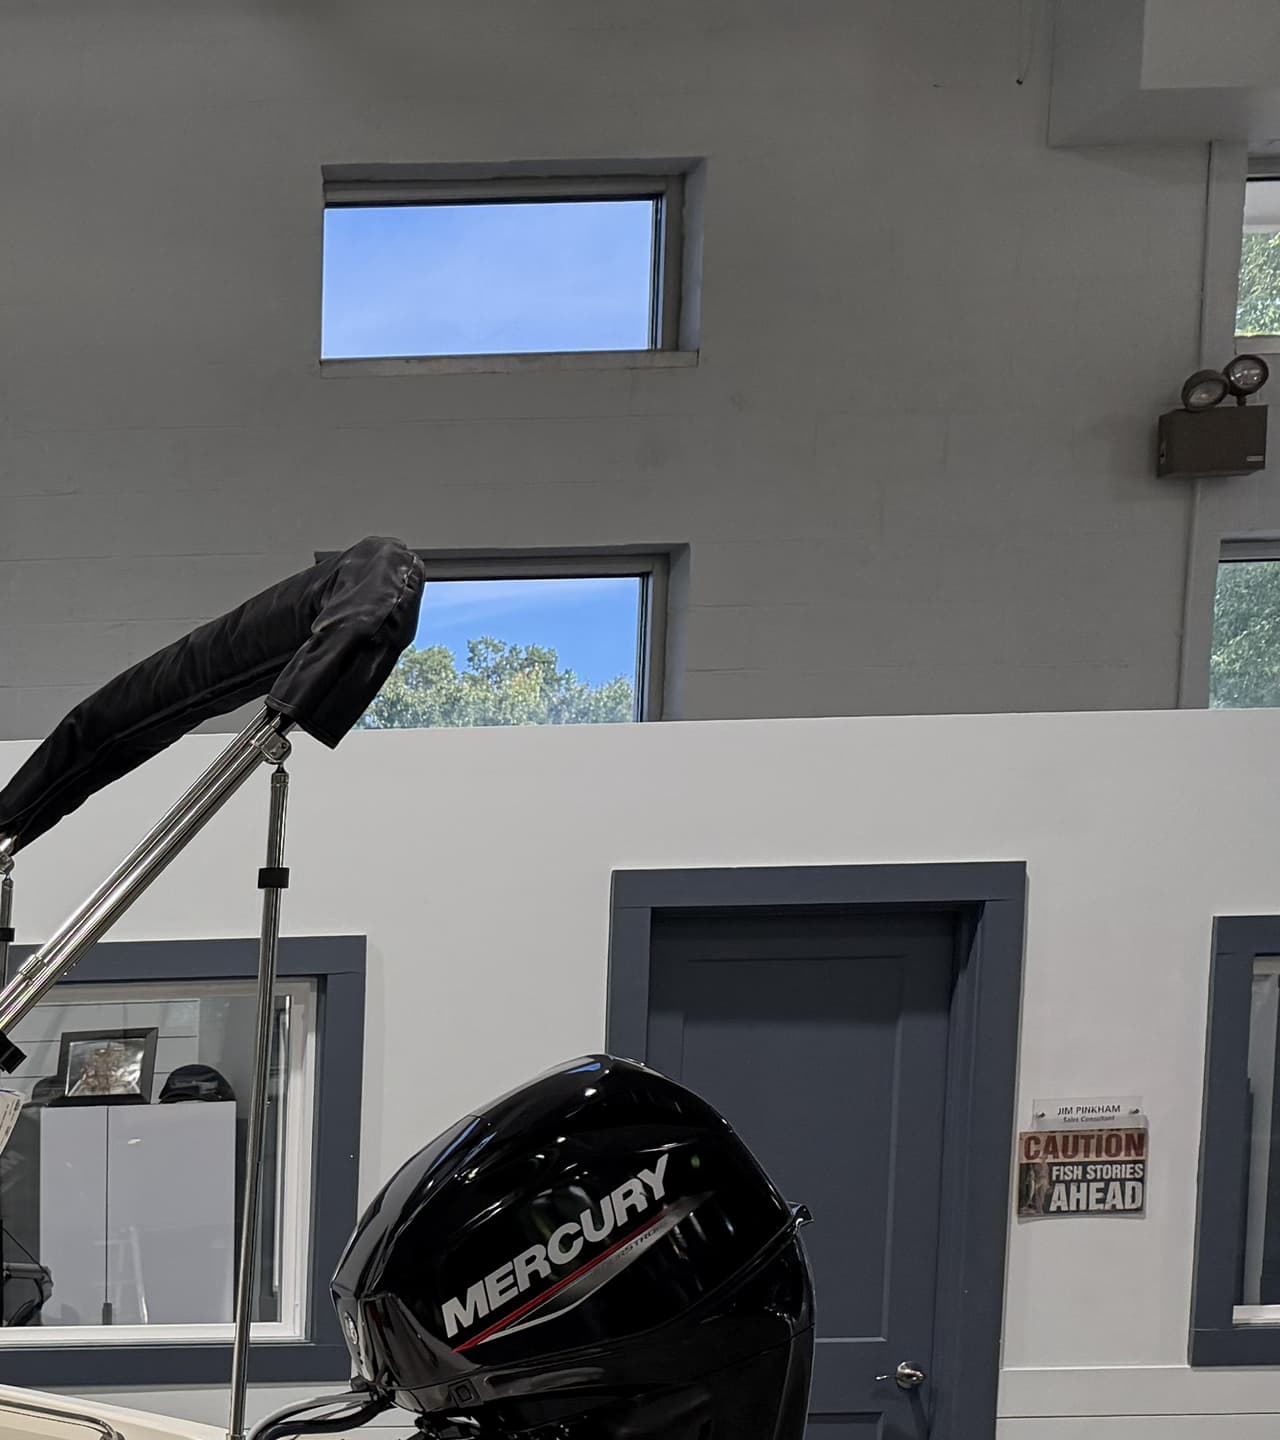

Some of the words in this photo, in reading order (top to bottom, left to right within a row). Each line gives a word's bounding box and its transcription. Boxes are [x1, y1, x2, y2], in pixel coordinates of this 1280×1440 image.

[1058, 1107, 1073, 1115] JIM
[1076, 1105, 1121, 1114] PINKHAM
[1024, 1133, 1145, 1160] CAUTION
[1052, 1165, 1082, 1181] FISH
[1086, 1164, 1144, 1180] STORIES
[1049, 1181, 1143, 1212] AHEAD
[441, 1154, 669, 1338] MERCURY
